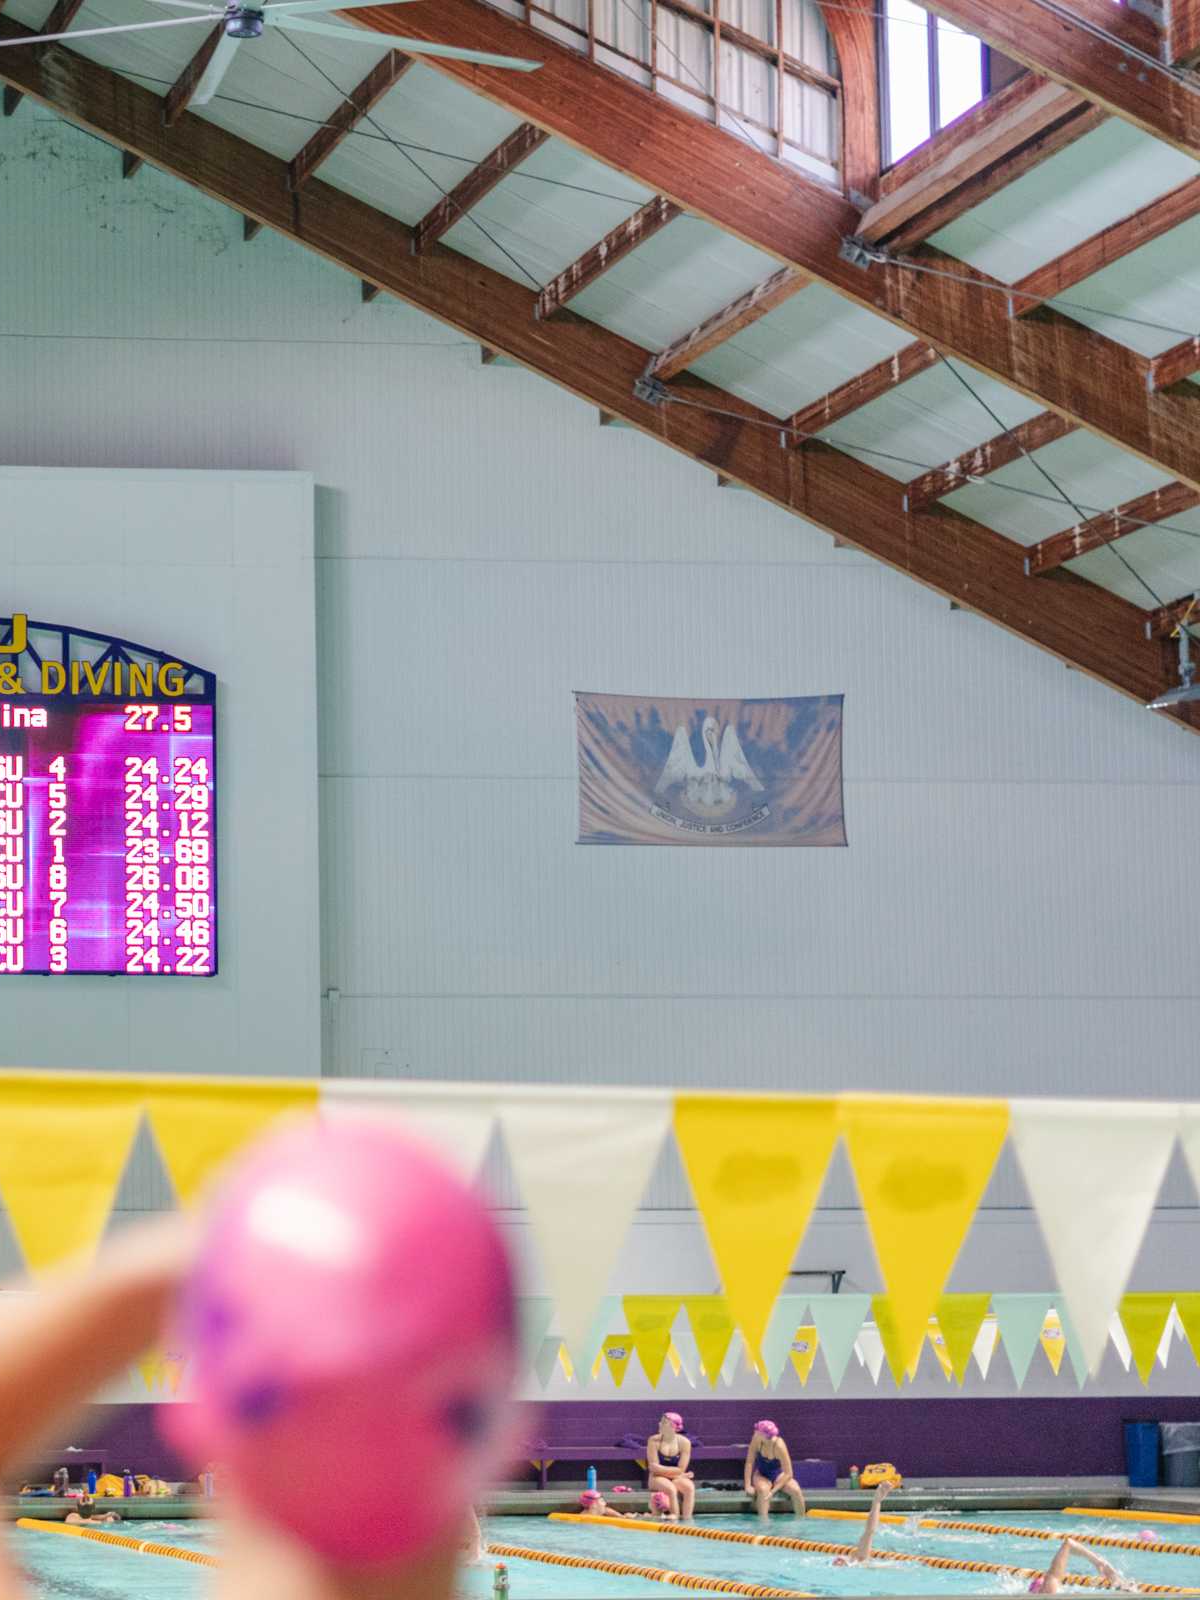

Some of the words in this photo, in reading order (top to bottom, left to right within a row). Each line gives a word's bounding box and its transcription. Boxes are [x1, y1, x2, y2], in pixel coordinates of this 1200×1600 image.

[41, 660, 186, 698] DIVING
[125, 704, 192, 732] 27.5
[49, 755, 67, 782] 4
[125, 755, 210, 782] 24.24
[49, 782, 67, 809] 5
[125, 782, 210, 809] 24.29
[49, 810, 67, 837] 2
[125, 810, 210, 837] 24.12
[52, 837, 65, 864] 1
[125, 837, 210, 864] 23.69
[49, 864, 67, 891] 8
[125, 864, 210, 891] 26.08
[49, 891, 67, 918] 7
[125, 891, 210, 918] 24.50
[49, 919, 67, 946] 6
[125, 919, 210, 946] 24.46
[49, 946, 67, 973] 3
[125, 946, 210, 973] 24.22
